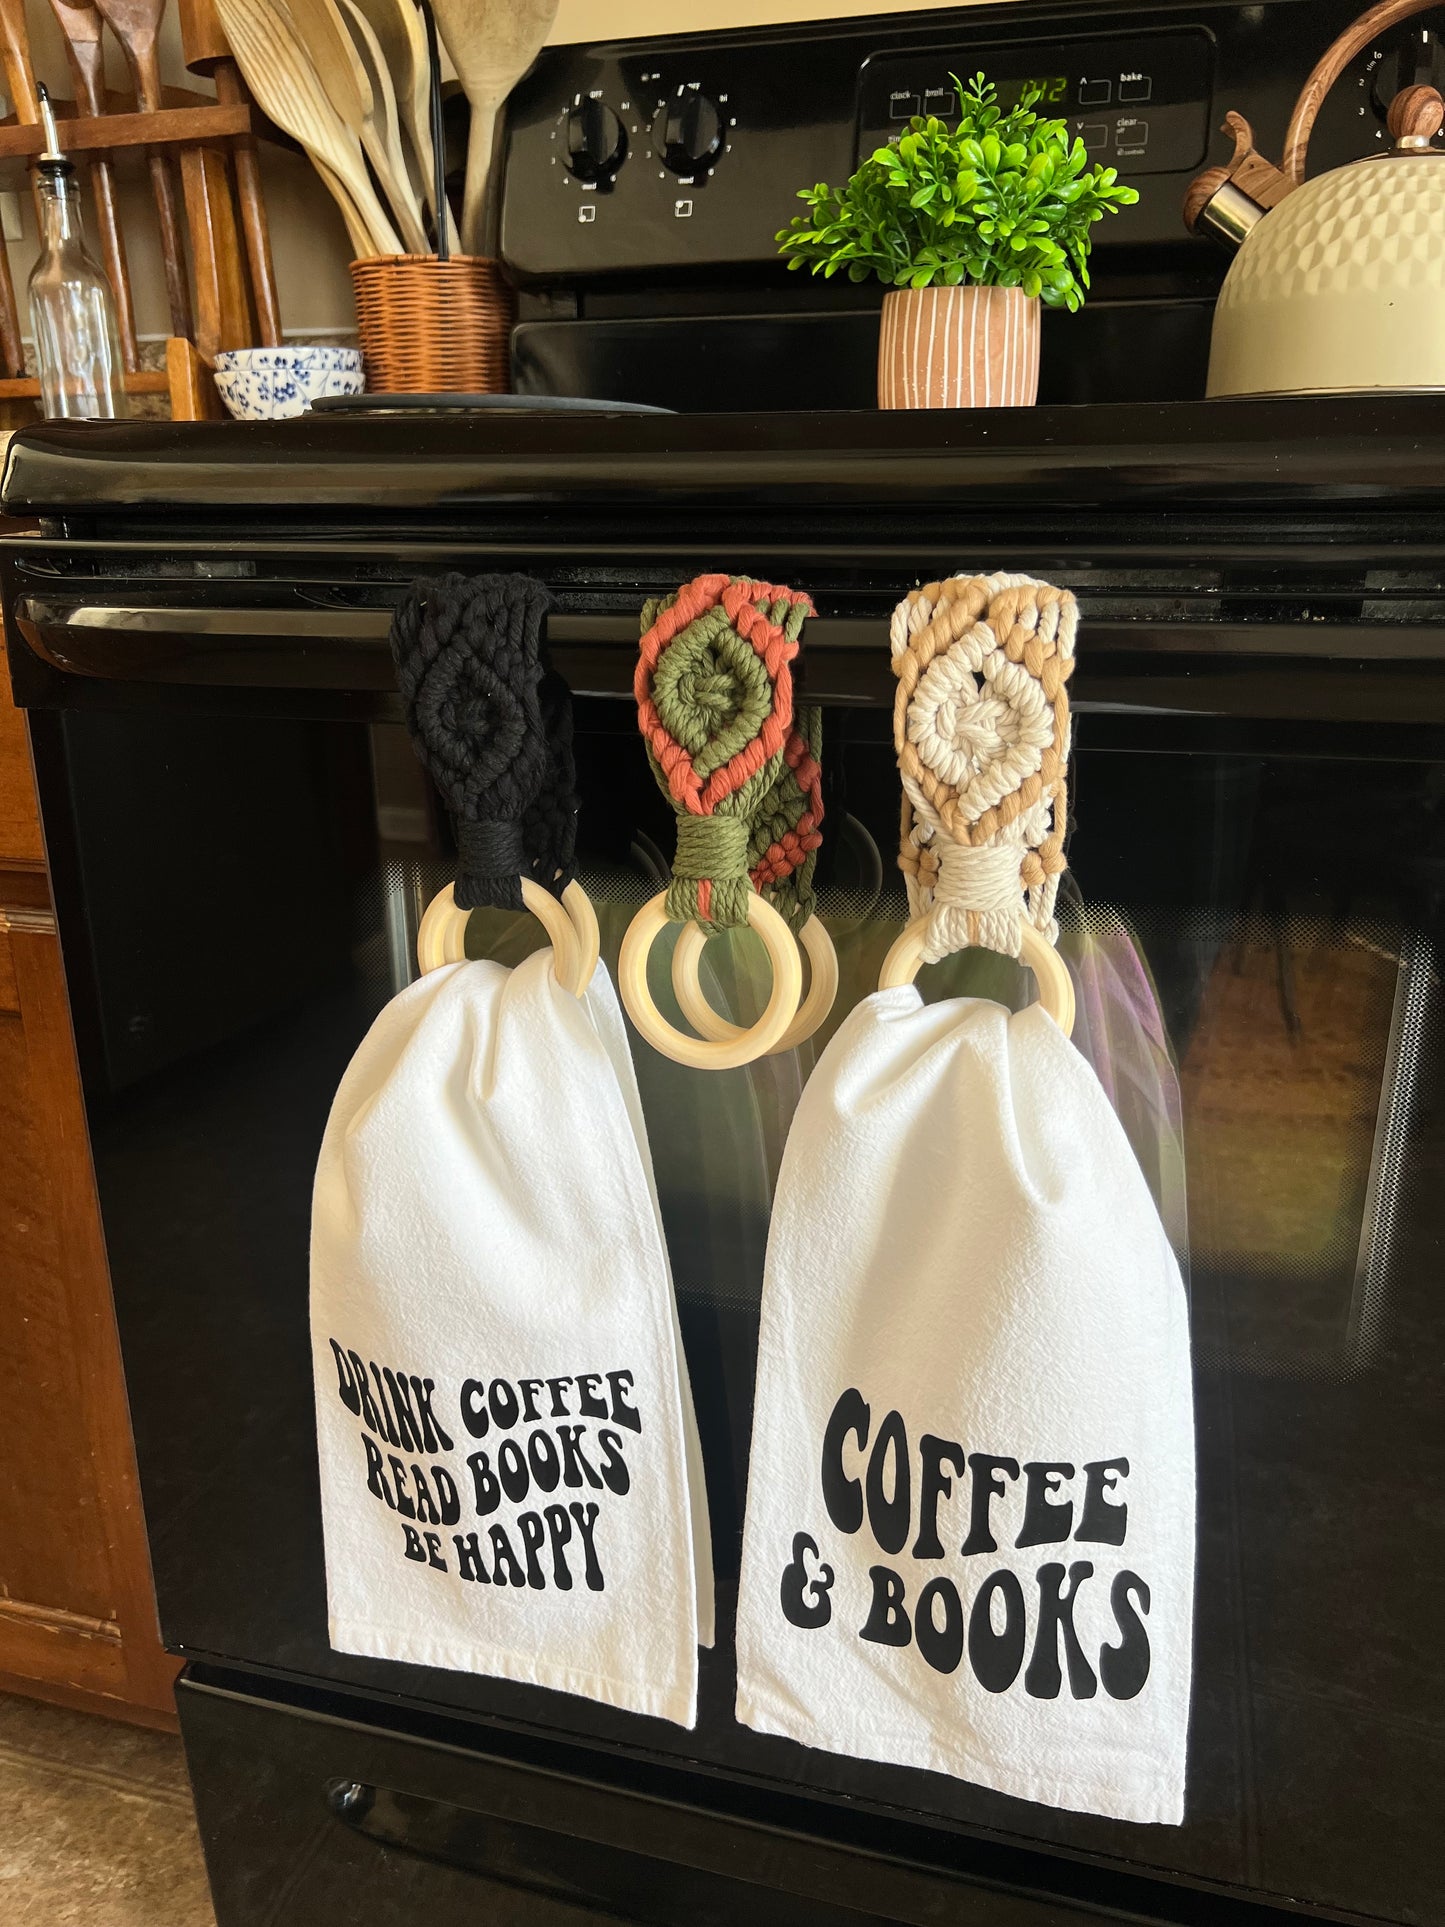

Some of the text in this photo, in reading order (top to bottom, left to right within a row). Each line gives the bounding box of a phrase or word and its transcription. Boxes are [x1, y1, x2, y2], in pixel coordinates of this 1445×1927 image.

[1120, 72, 1143, 82] bake
[1358, 78, 1365, 87] 2
[589, 90, 603, 99] OFF
[889, 90, 911, 100] clock
[924, 87, 944, 98] broil
[1358, 107, 1365, 116] 3
[1116, 118, 1138, 127] clear
[1375, 130, 1382, 139] 4
[1437, 128, 1444, 137] 6
[329, 1337, 642, 1454] DRINK COFFEE
[361, 1424, 630, 1526] READ BOOKS
[821, 1387, 1130, 1560] COFFEE
[401, 1501, 605, 1592] BE HAPPY
[780, 1531, 1151, 1701] & BOOKS
